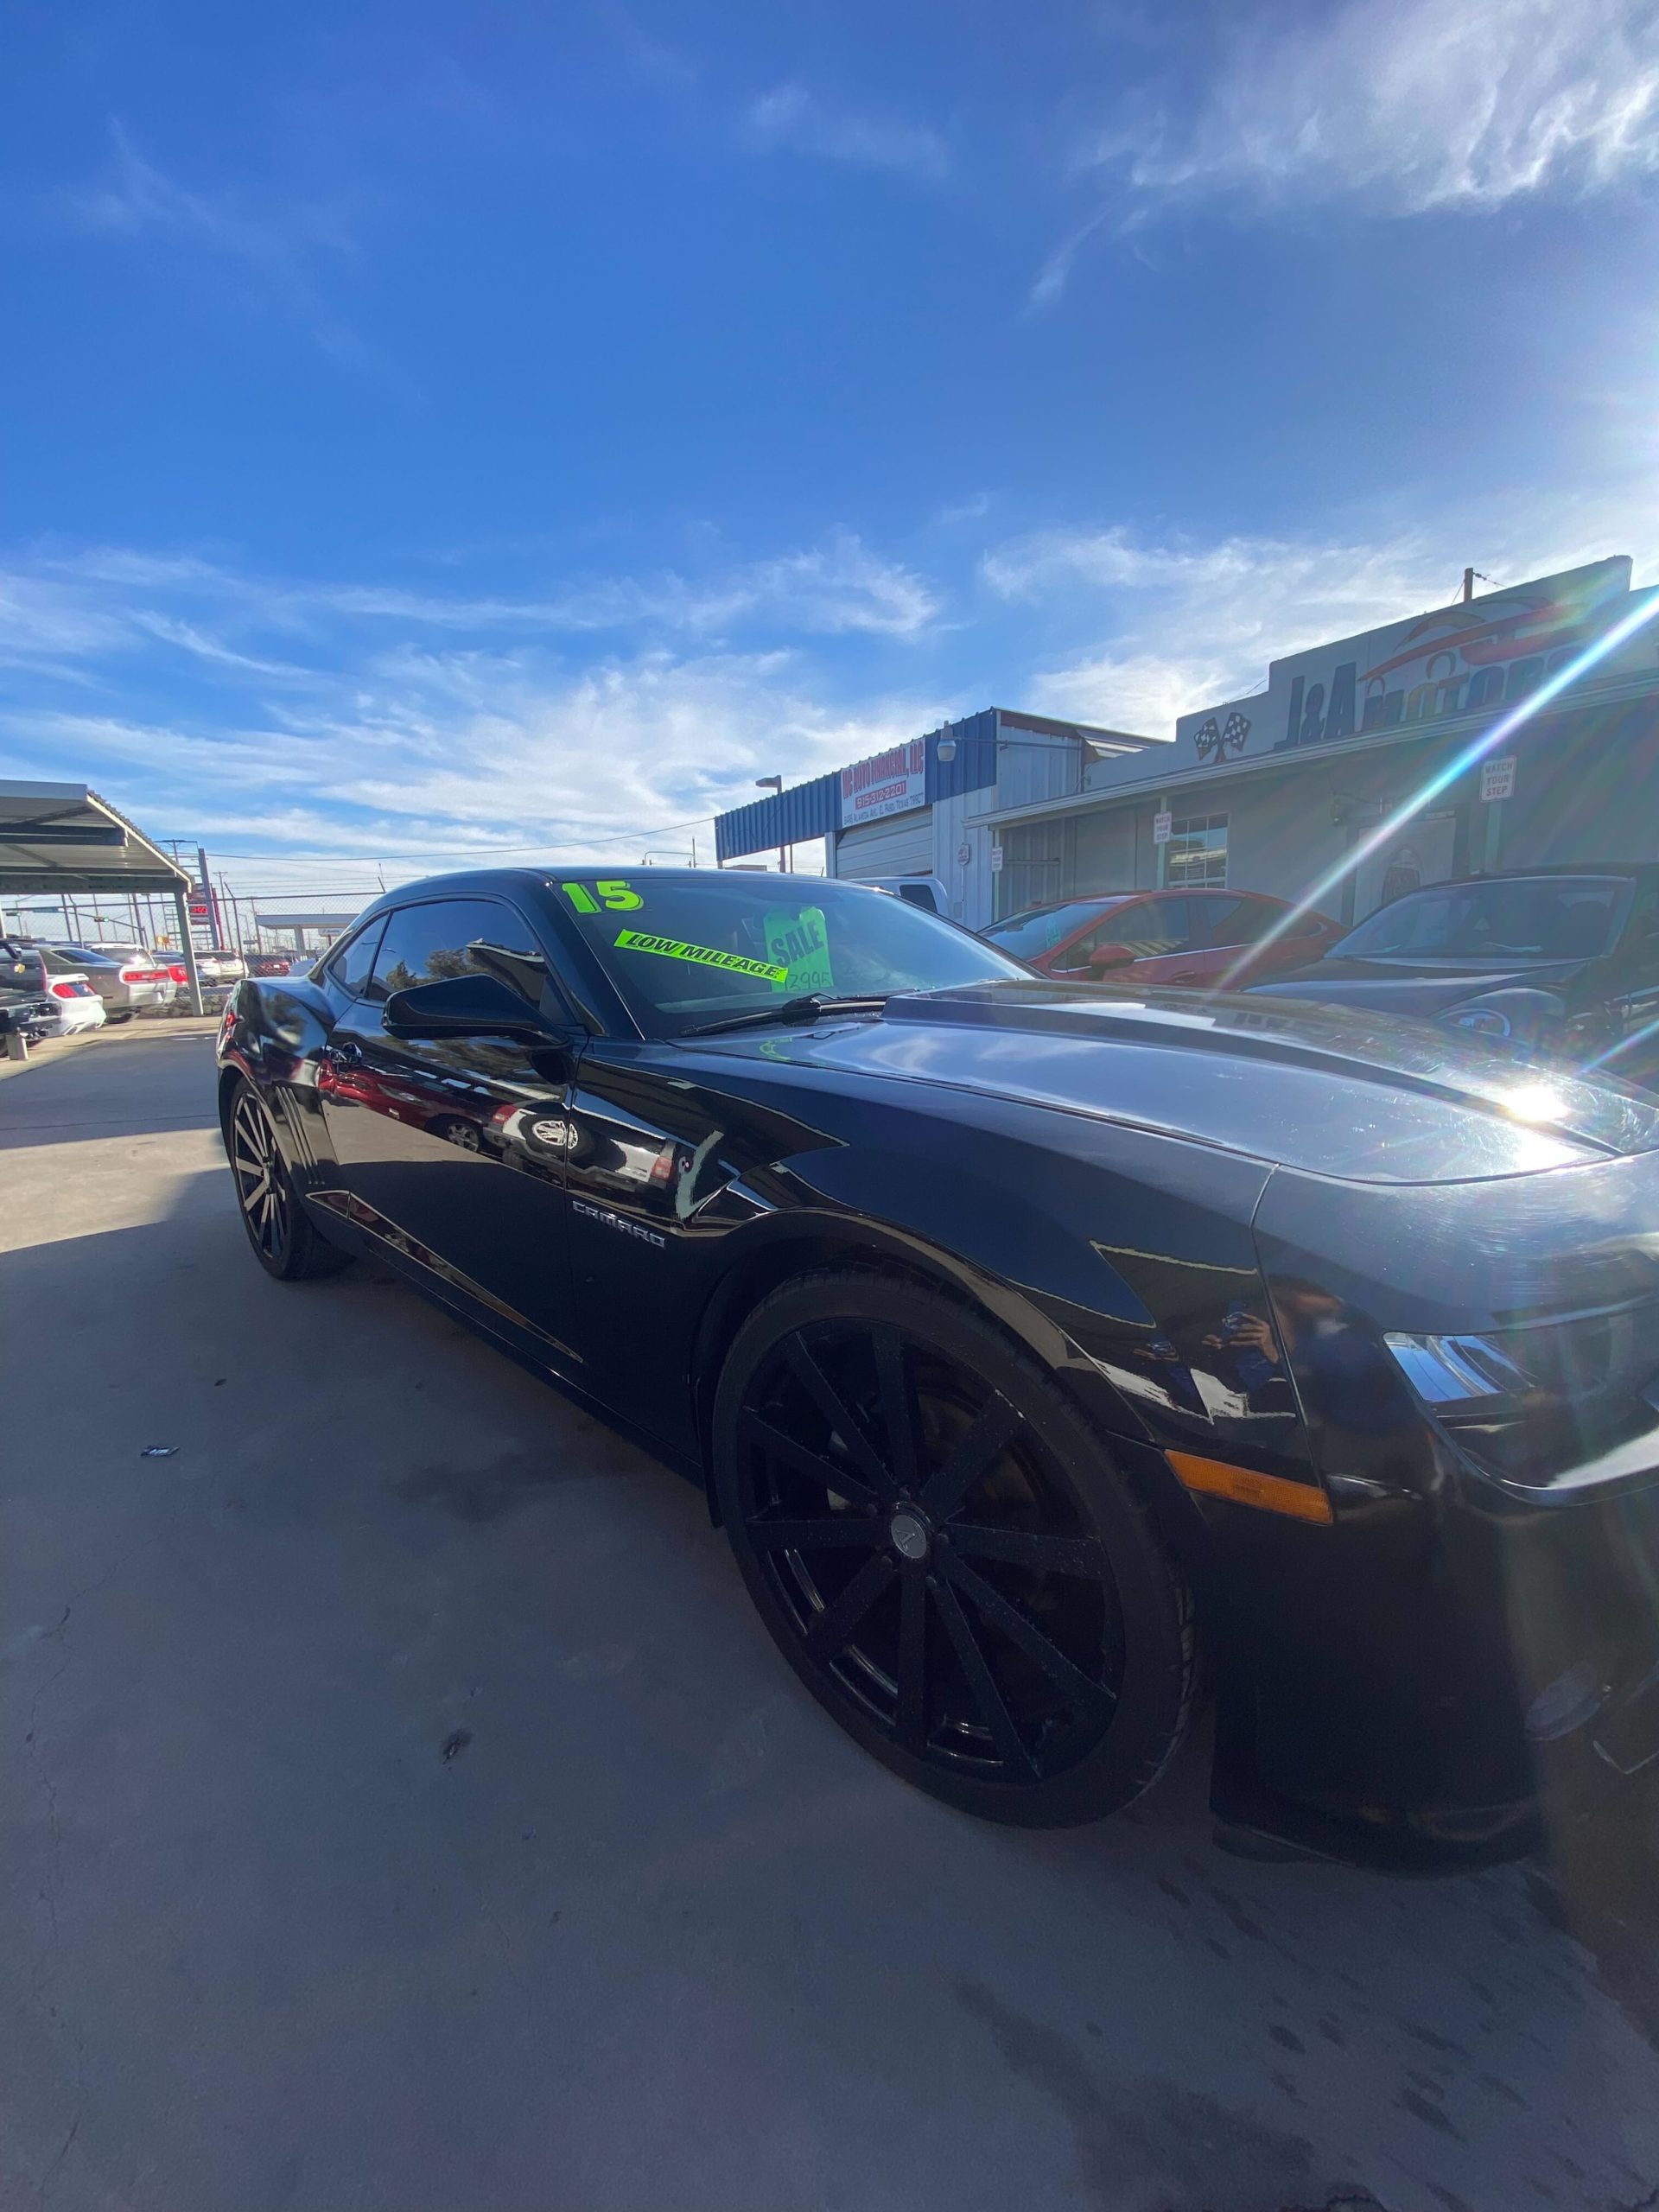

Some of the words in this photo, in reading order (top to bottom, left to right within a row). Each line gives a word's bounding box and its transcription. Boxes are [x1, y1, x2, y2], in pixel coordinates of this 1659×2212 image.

[855, 782, 906, 809] 915-312-2201
[1486, 785, 1508, 796] STEP
[562, 880, 643, 913] 15
[626, 933, 677, 953] LOW
[772, 921, 824, 969] SALE
[572, 1201, 665, 1249] CAMARO
